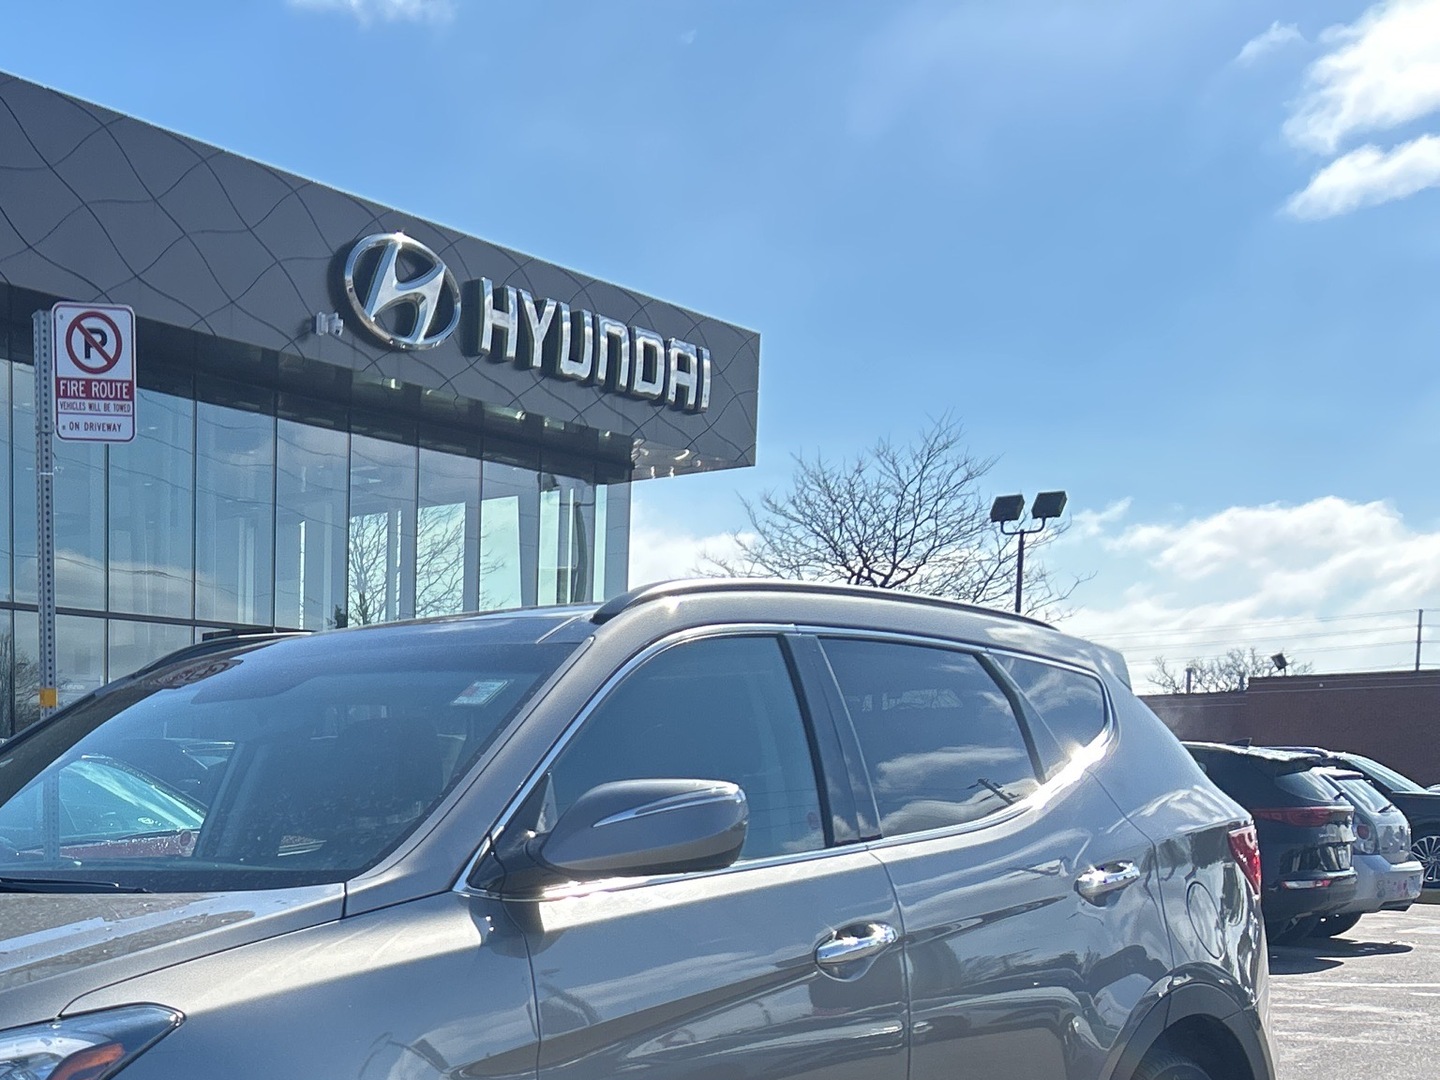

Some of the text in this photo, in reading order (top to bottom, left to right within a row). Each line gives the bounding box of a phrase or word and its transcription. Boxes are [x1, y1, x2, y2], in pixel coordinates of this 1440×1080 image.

[478, 276, 711, 413] HYUNDAI
[60, 380, 130, 399] FIRE ROUTE
[60, 401, 131, 413] VEHICLES WILL BE TOWED
[69, 421, 122, 432] ON DRIVEWAY
